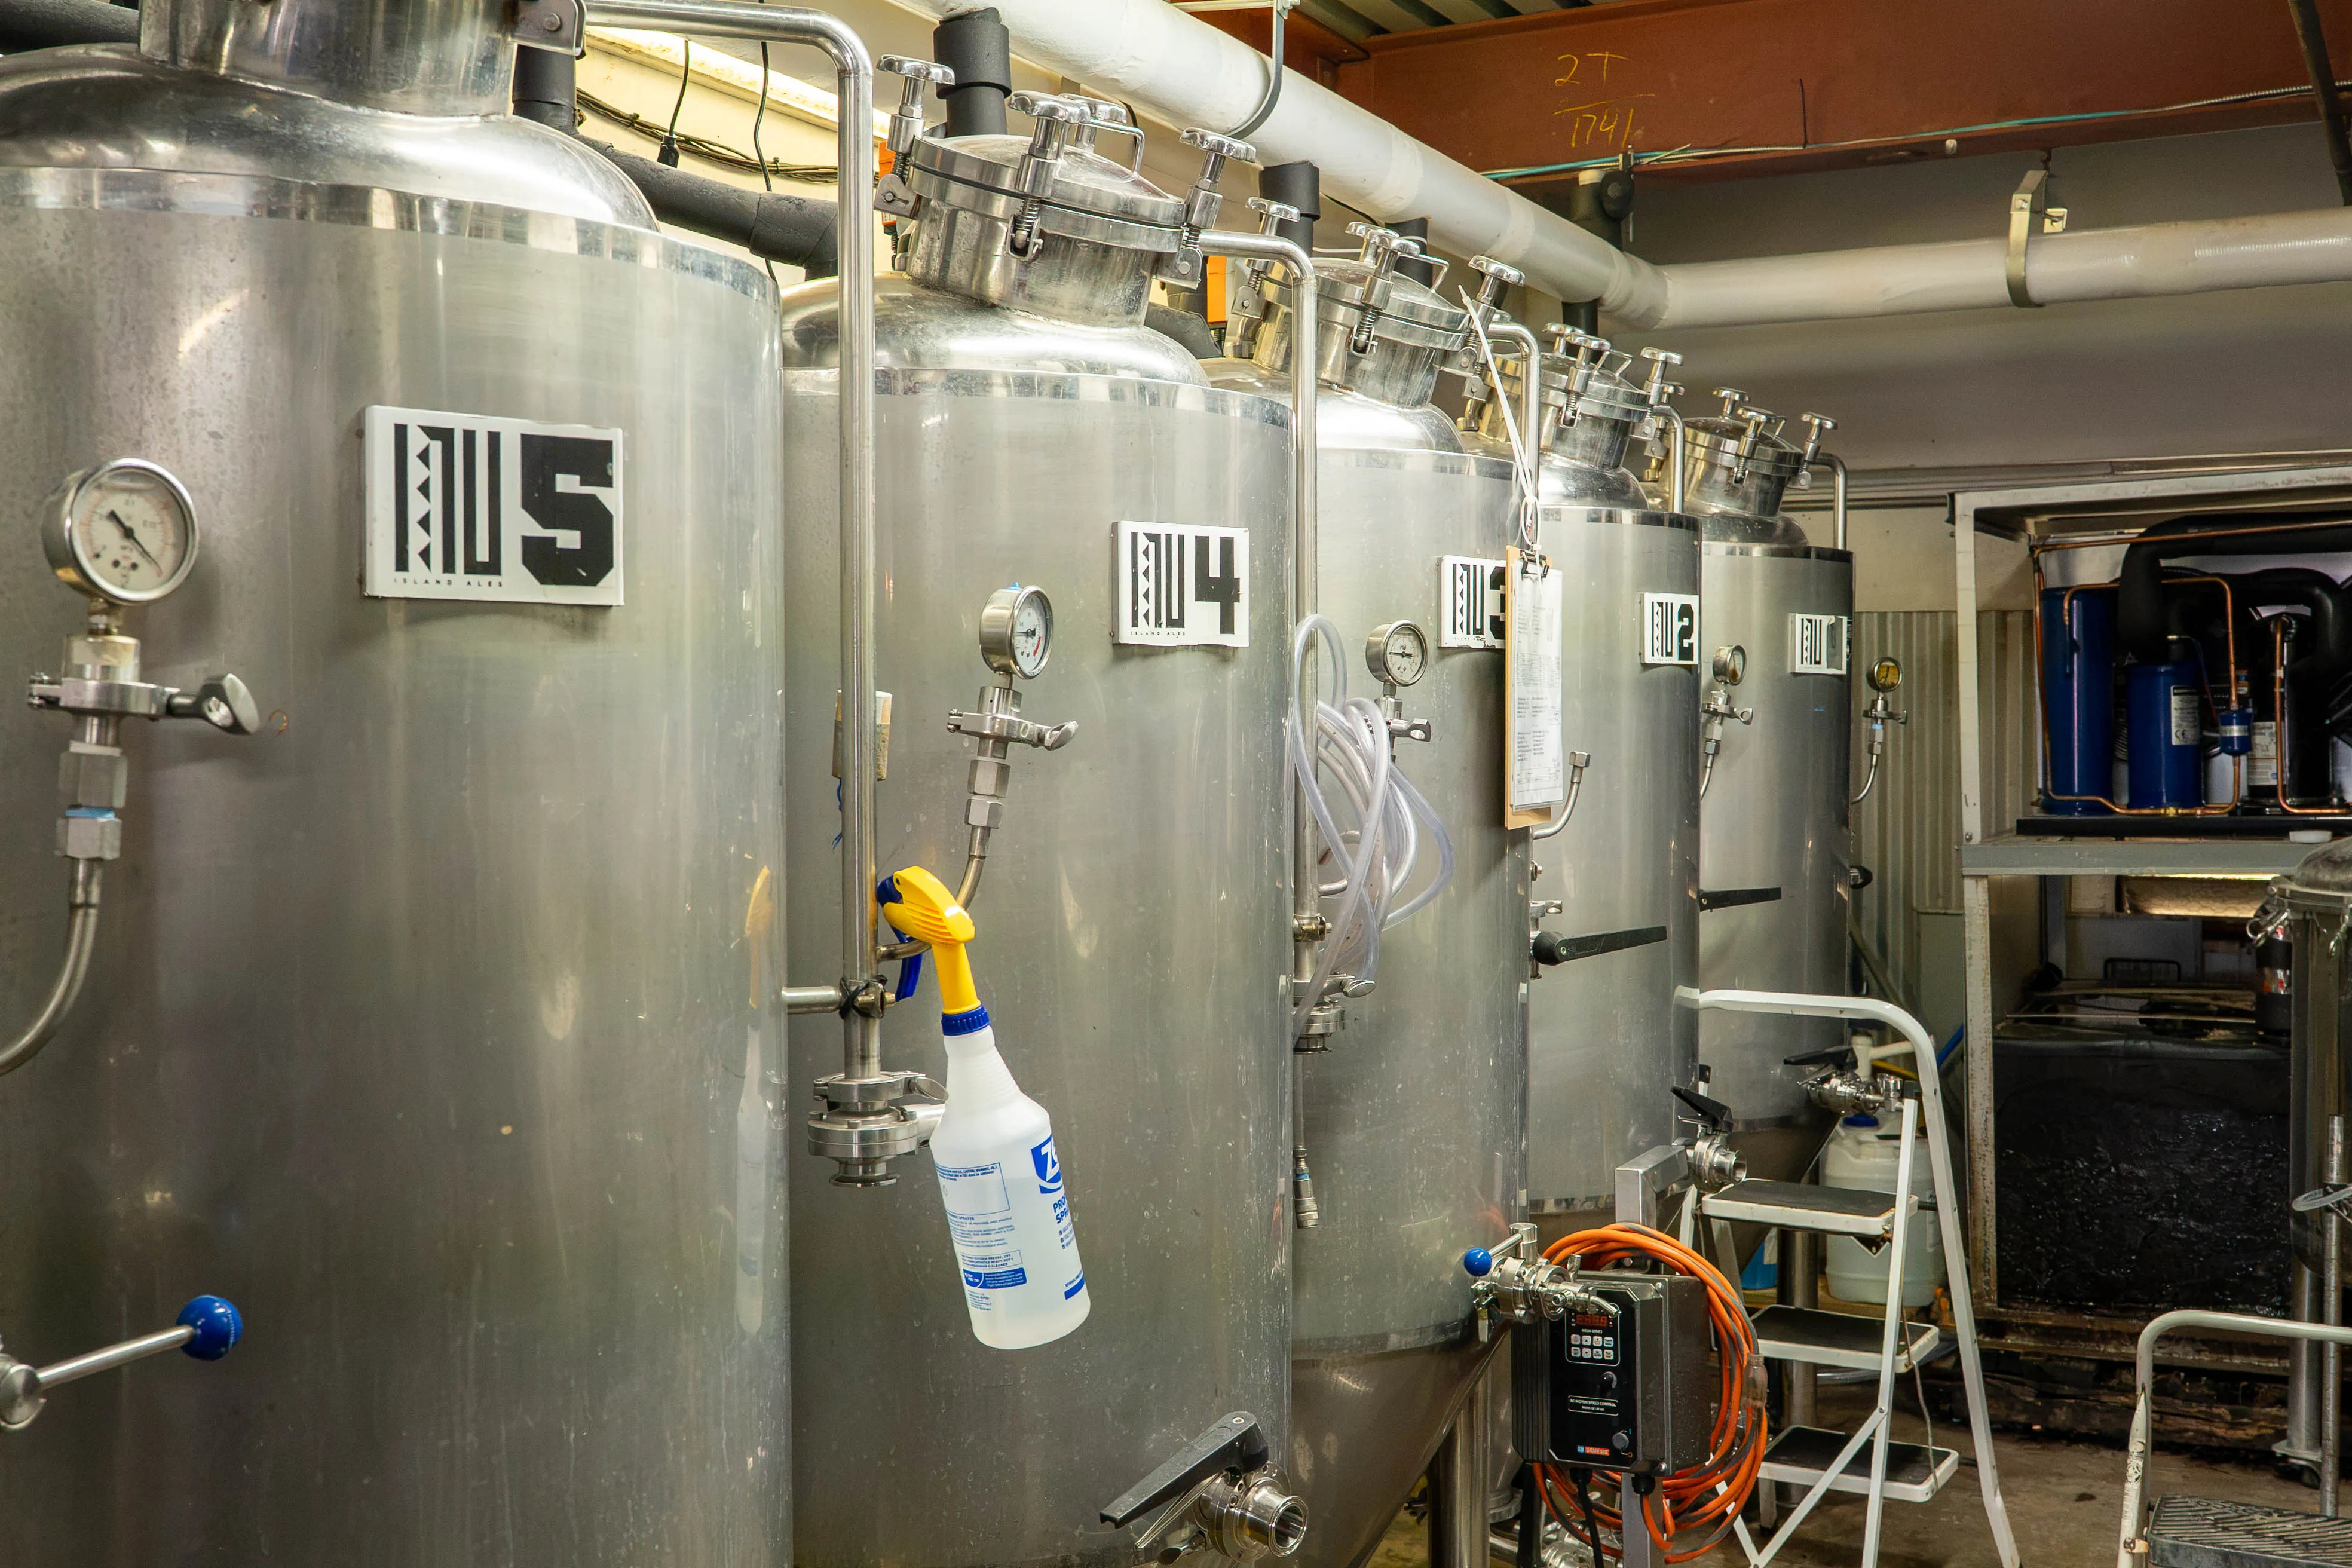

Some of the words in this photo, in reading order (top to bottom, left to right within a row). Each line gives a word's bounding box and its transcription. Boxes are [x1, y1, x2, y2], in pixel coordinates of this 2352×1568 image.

[1195, 535, 1241, 635] 4
[1677, 603, 1694, 662] 2
[1052, 1194, 1068, 1214] PRO
